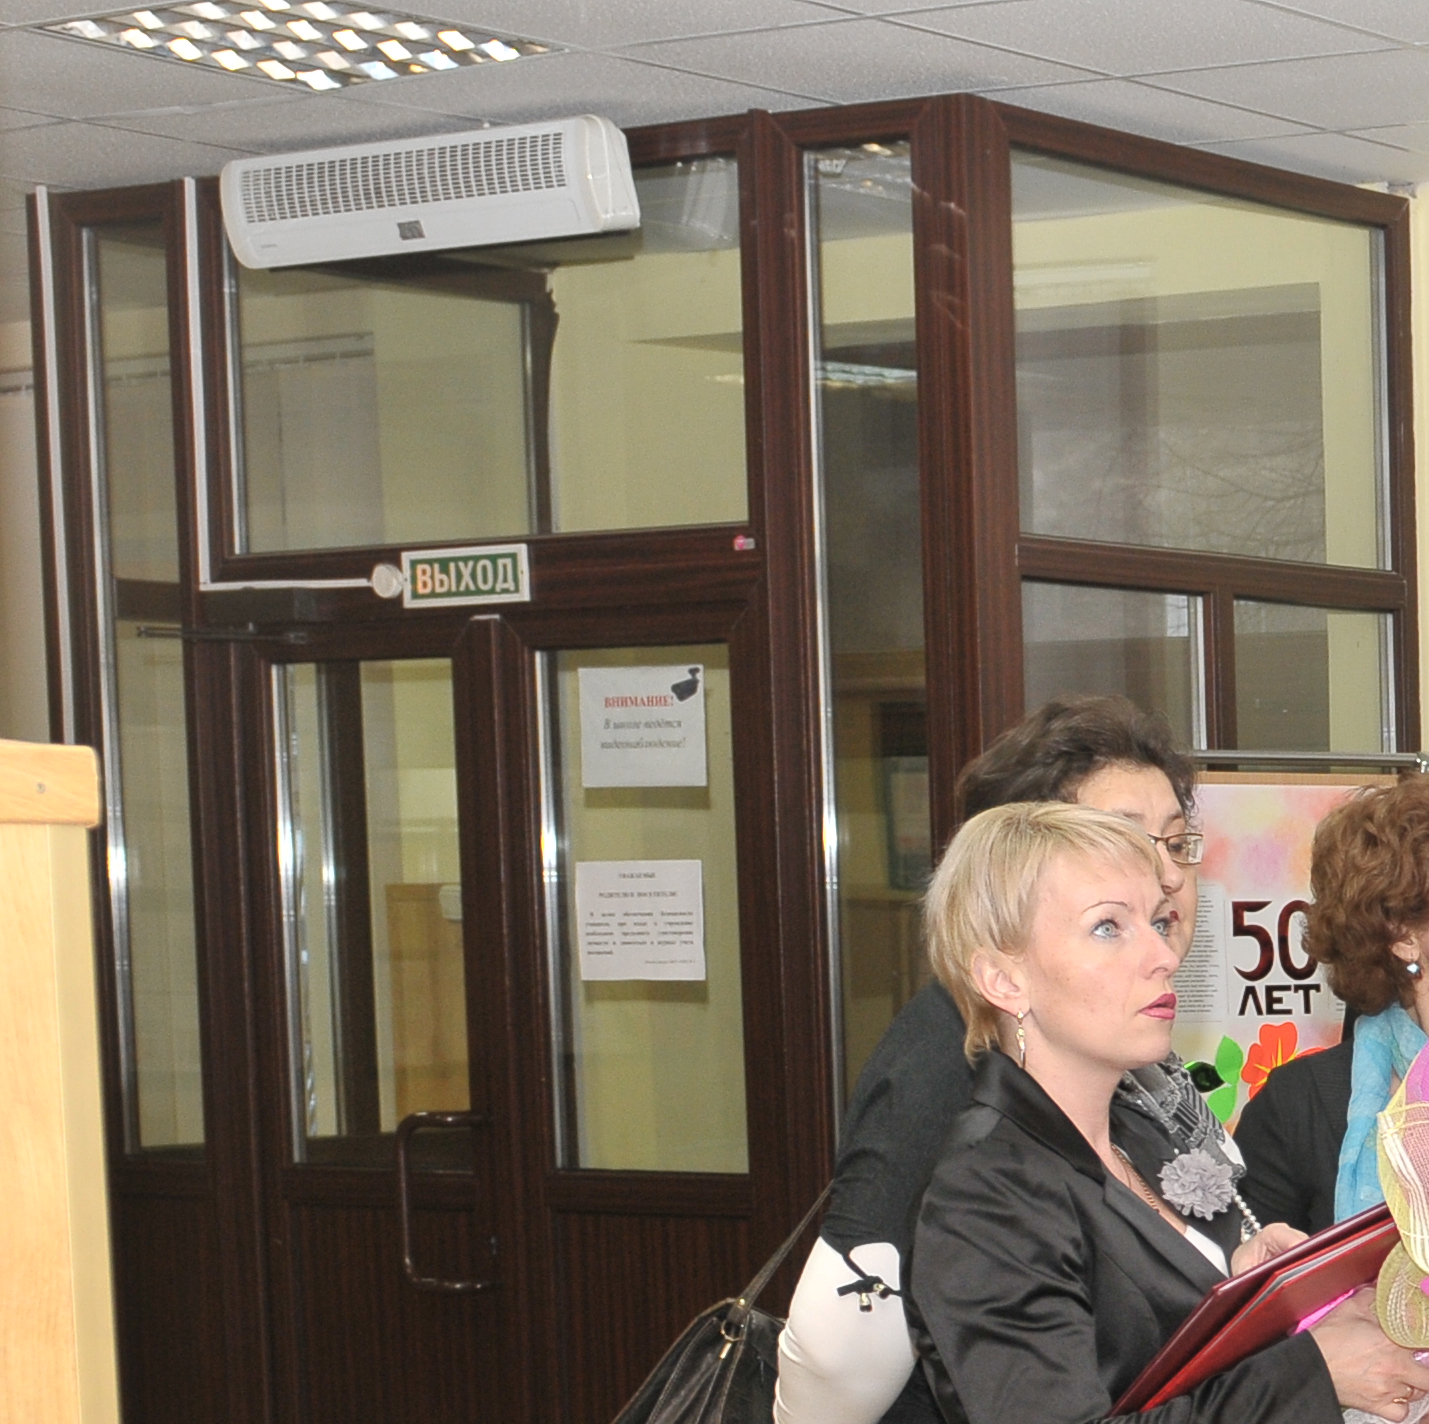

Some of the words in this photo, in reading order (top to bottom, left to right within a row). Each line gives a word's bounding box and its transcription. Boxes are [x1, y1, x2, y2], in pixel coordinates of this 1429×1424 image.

[416, 558, 515, 594] ВЫХОД
[604, 695, 674, 708] ВНИМАНИЕ!
[1232, 900, 1318, 982] 50
[1238, 983, 1321, 1016] ЛЕТ
